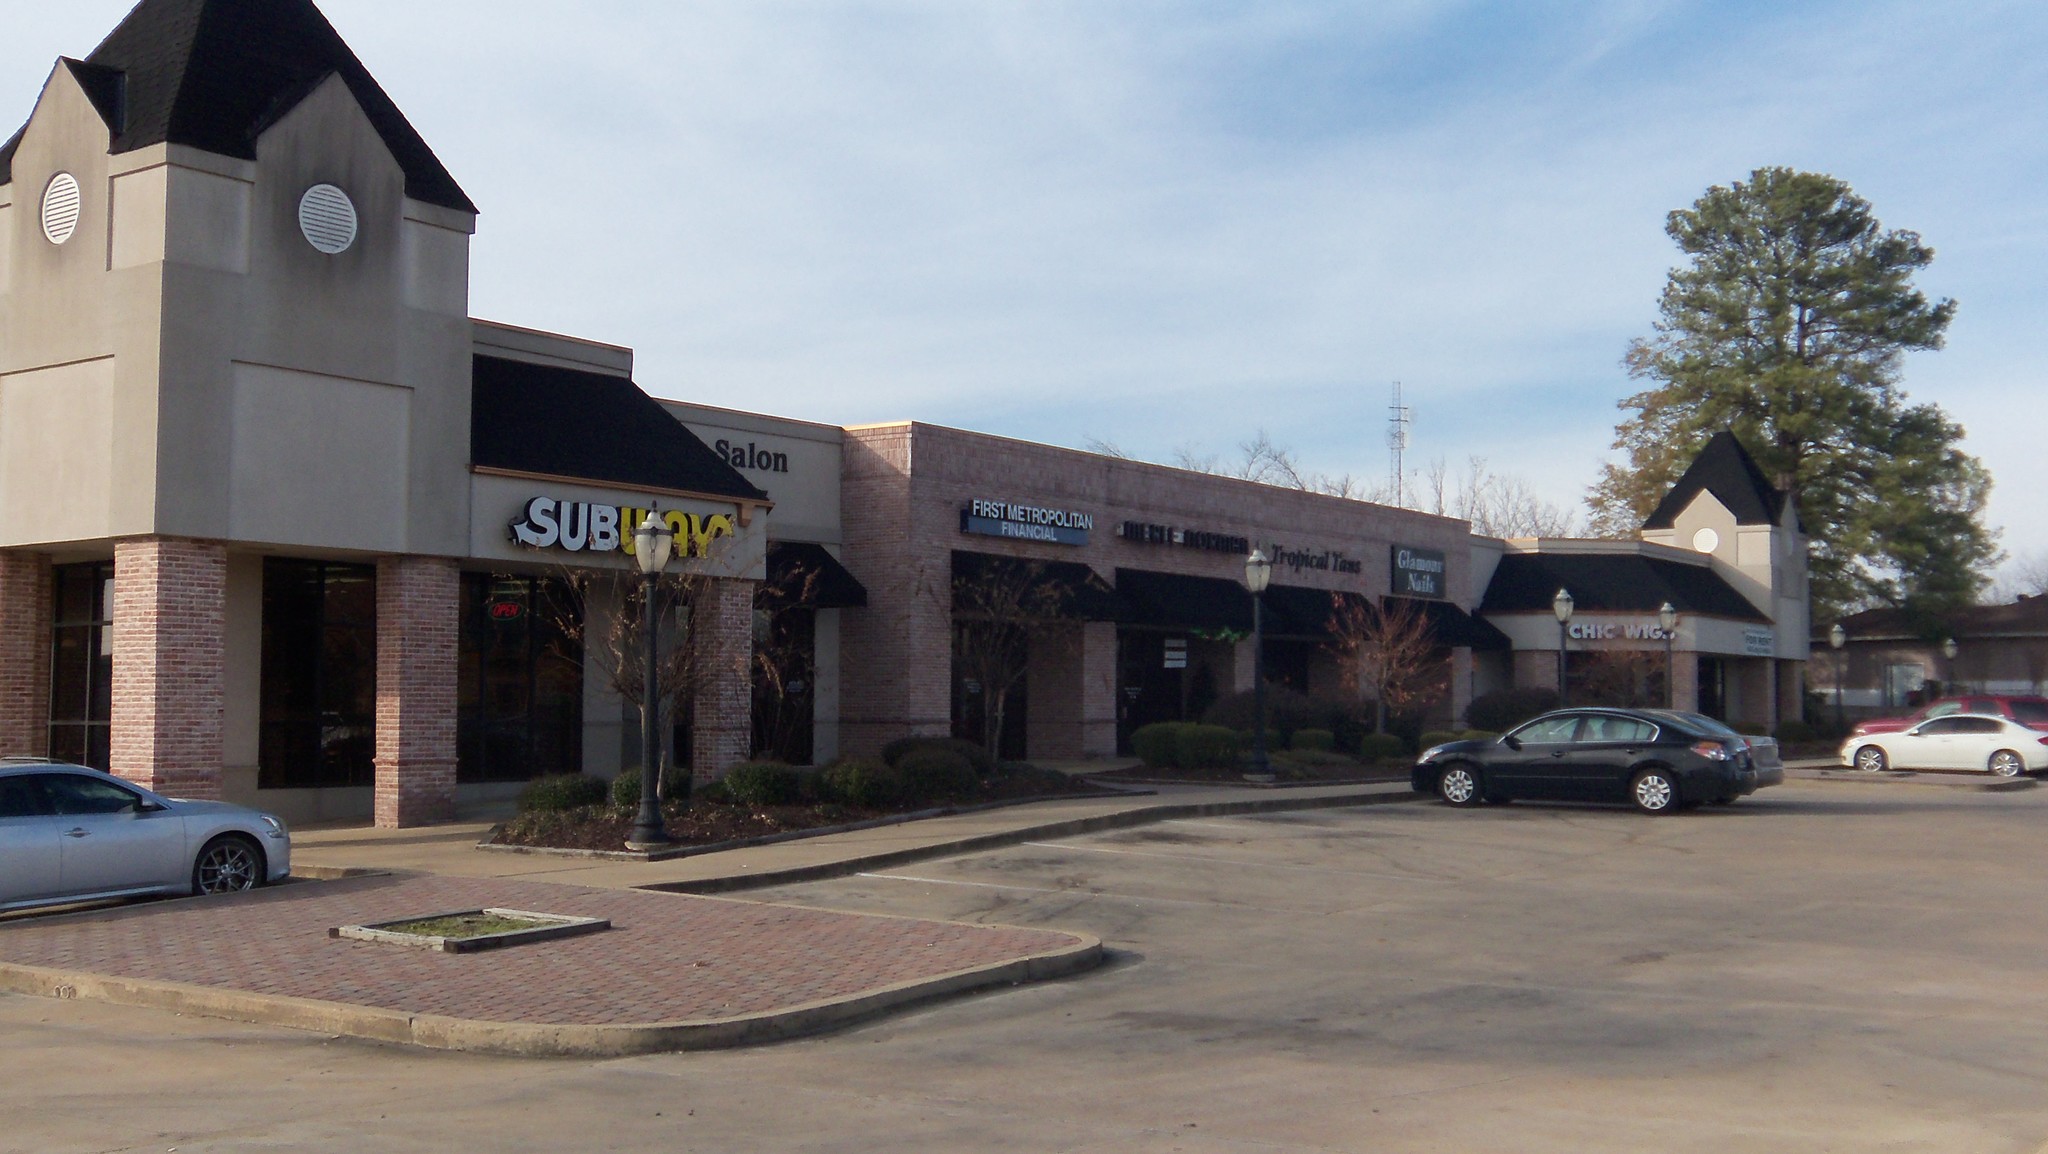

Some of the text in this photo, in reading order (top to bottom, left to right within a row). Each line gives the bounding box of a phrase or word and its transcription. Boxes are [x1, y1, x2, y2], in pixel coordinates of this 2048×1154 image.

[715, 439, 788, 472] Salon
[972, 499, 1093, 529] FIRST METROPOLITAN
[1001, 521, 1057, 540] FINANCIAL
[1271, 544, 1330, 573] Tropical
[1398, 550, 1443, 573] Glamour
[1408, 572, 1435, 593] Nails
[492, 603, 519, 617] OPEN
[1569, 623, 1616, 639] CHIC
